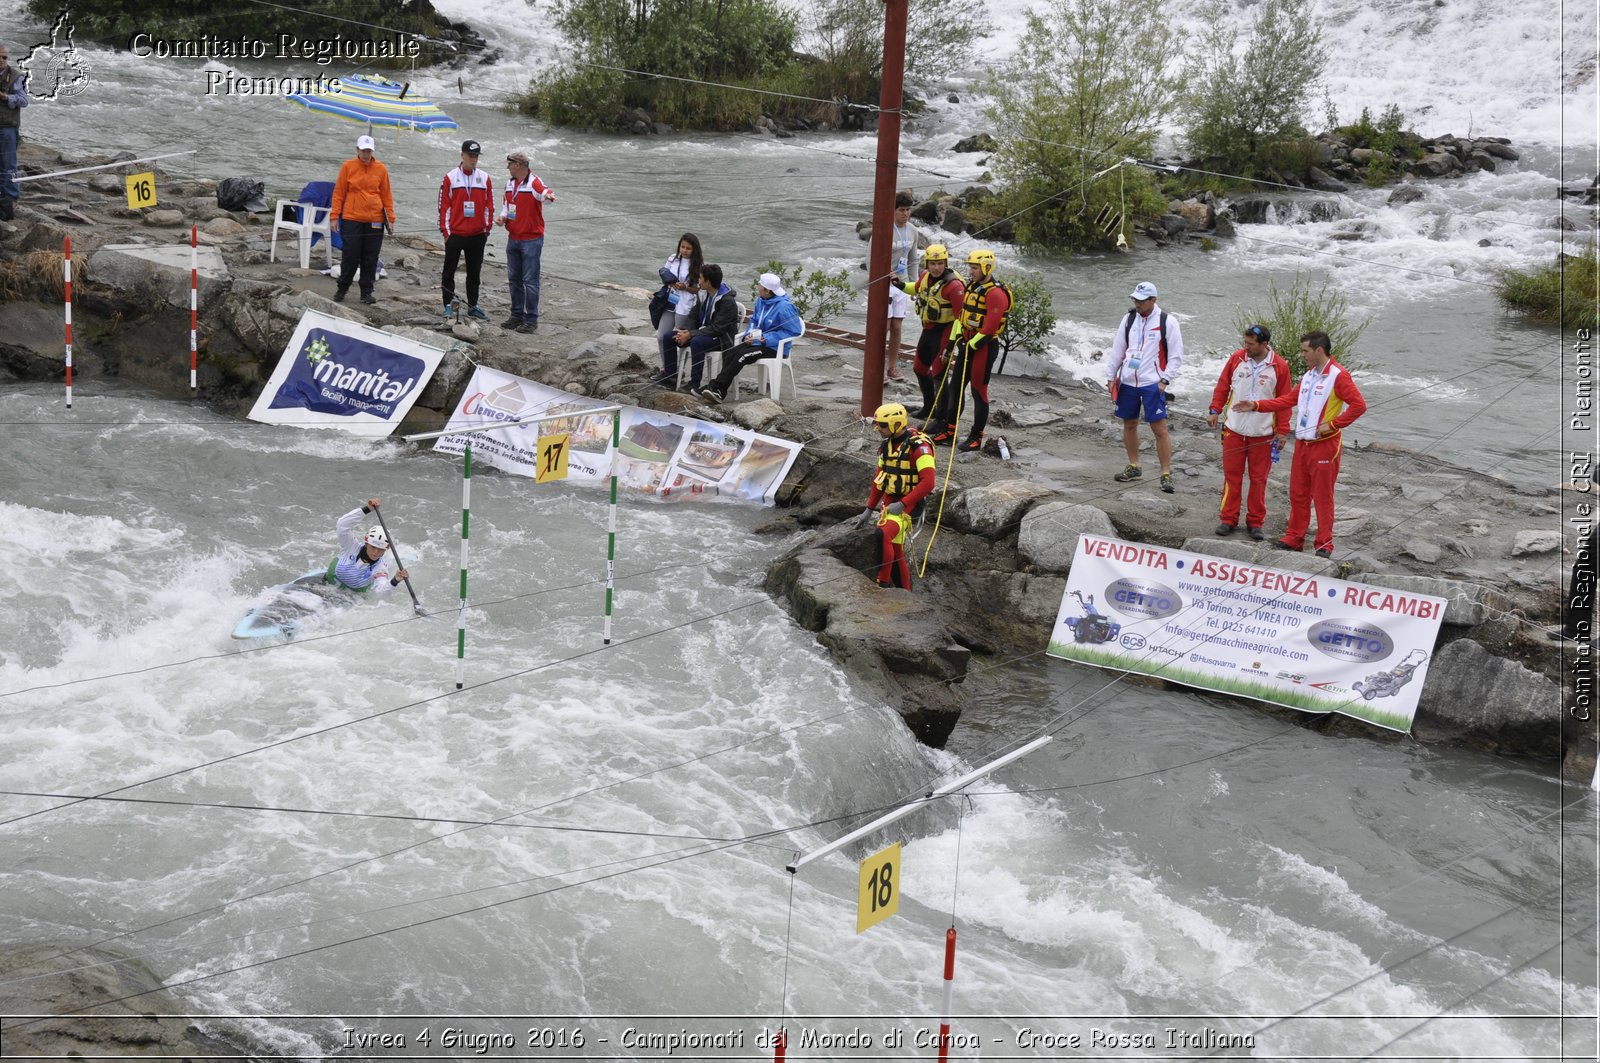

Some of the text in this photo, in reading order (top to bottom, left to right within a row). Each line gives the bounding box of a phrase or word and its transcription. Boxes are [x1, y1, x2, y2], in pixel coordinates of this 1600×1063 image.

[133, 181, 151, 202] 16
[313, 359, 414, 402] manital
[321, 387, 347, 405] facility
[544, 443, 563, 472] 17
[1084, 538, 1440, 620] VENDITA ASSISTENZA RICAMBI
[1114, 589, 1171, 610] GETTO
[1178, 581, 1322, 616] www.gettomacchineagricole.com
[1192, 598, 1204, 609] Via
[1207, 601, 1234, 616] Torino,
[1237, 607, 1248, 618] 26
[1255, 610, 1281, 624] IVREA
[1283, 616, 1301, 628] (TO)
[1206, 617, 1277, 638] Tel. 0125 641410
[1122, 635, 1144, 647] BCS
[1149, 645, 1185, 658] HITACHI
[1165, 623, 1309, 661] info@gettomacchineagricole.com
[1318, 630, 1382, 653] GETTO
[1198, 655, 1236, 669] Husqvarna
[868, 862, 892, 913] 18
